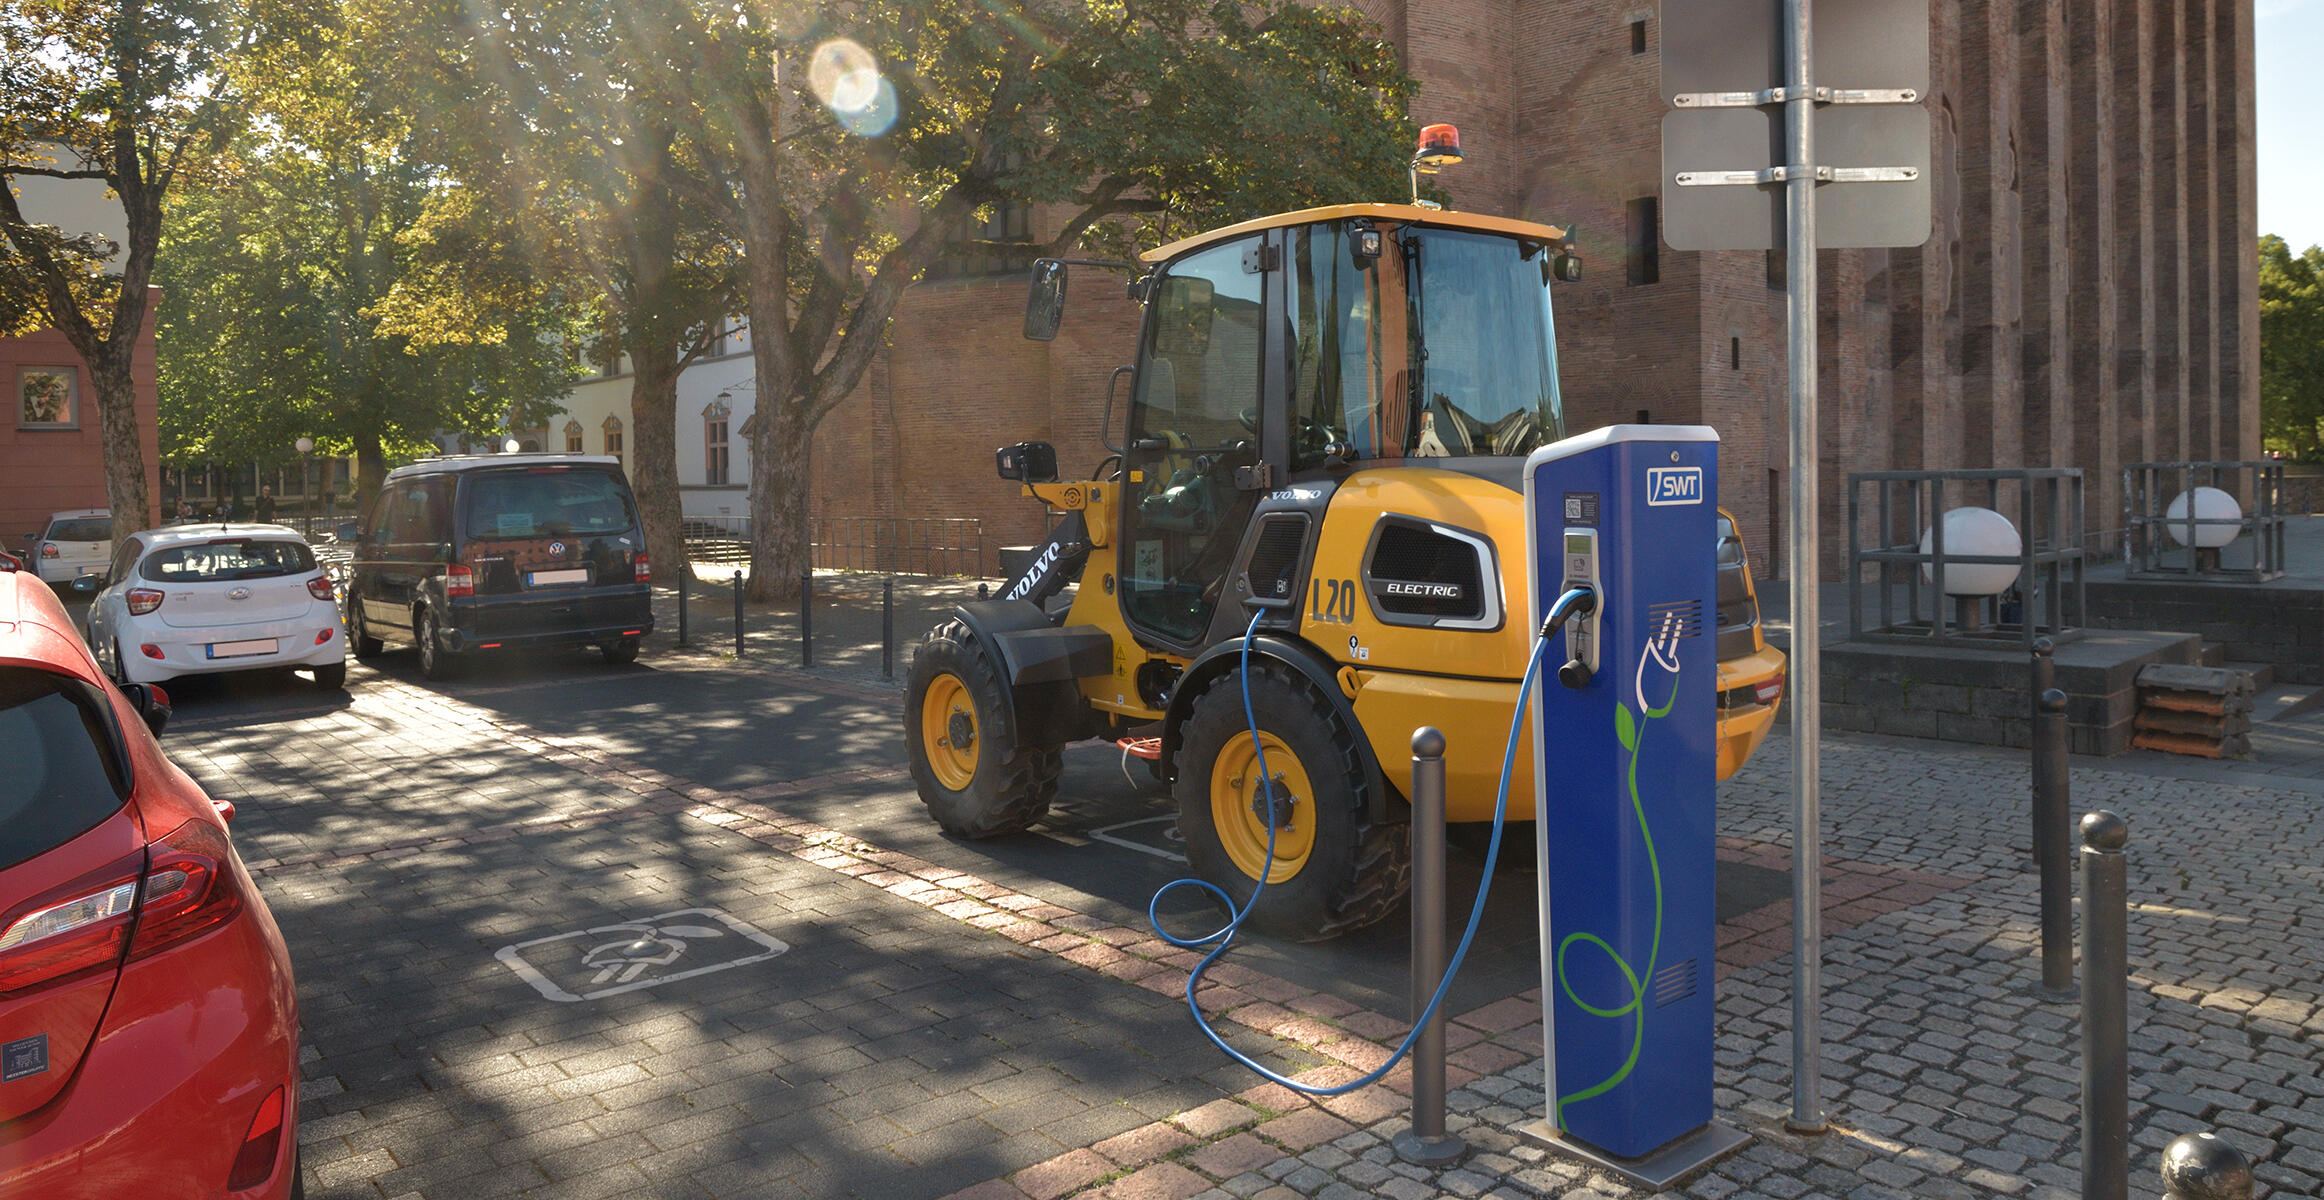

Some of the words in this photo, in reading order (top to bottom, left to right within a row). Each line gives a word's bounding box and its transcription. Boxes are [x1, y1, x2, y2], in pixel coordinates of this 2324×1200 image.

[1272, 490, 1321, 500] VOO
[1663, 476, 1697, 497] SWT
[1006, 542, 1060, 601] VOLVO
[1387, 583, 1458, 597] ELECTRIC
[1312, 578, 1355, 624] L20
